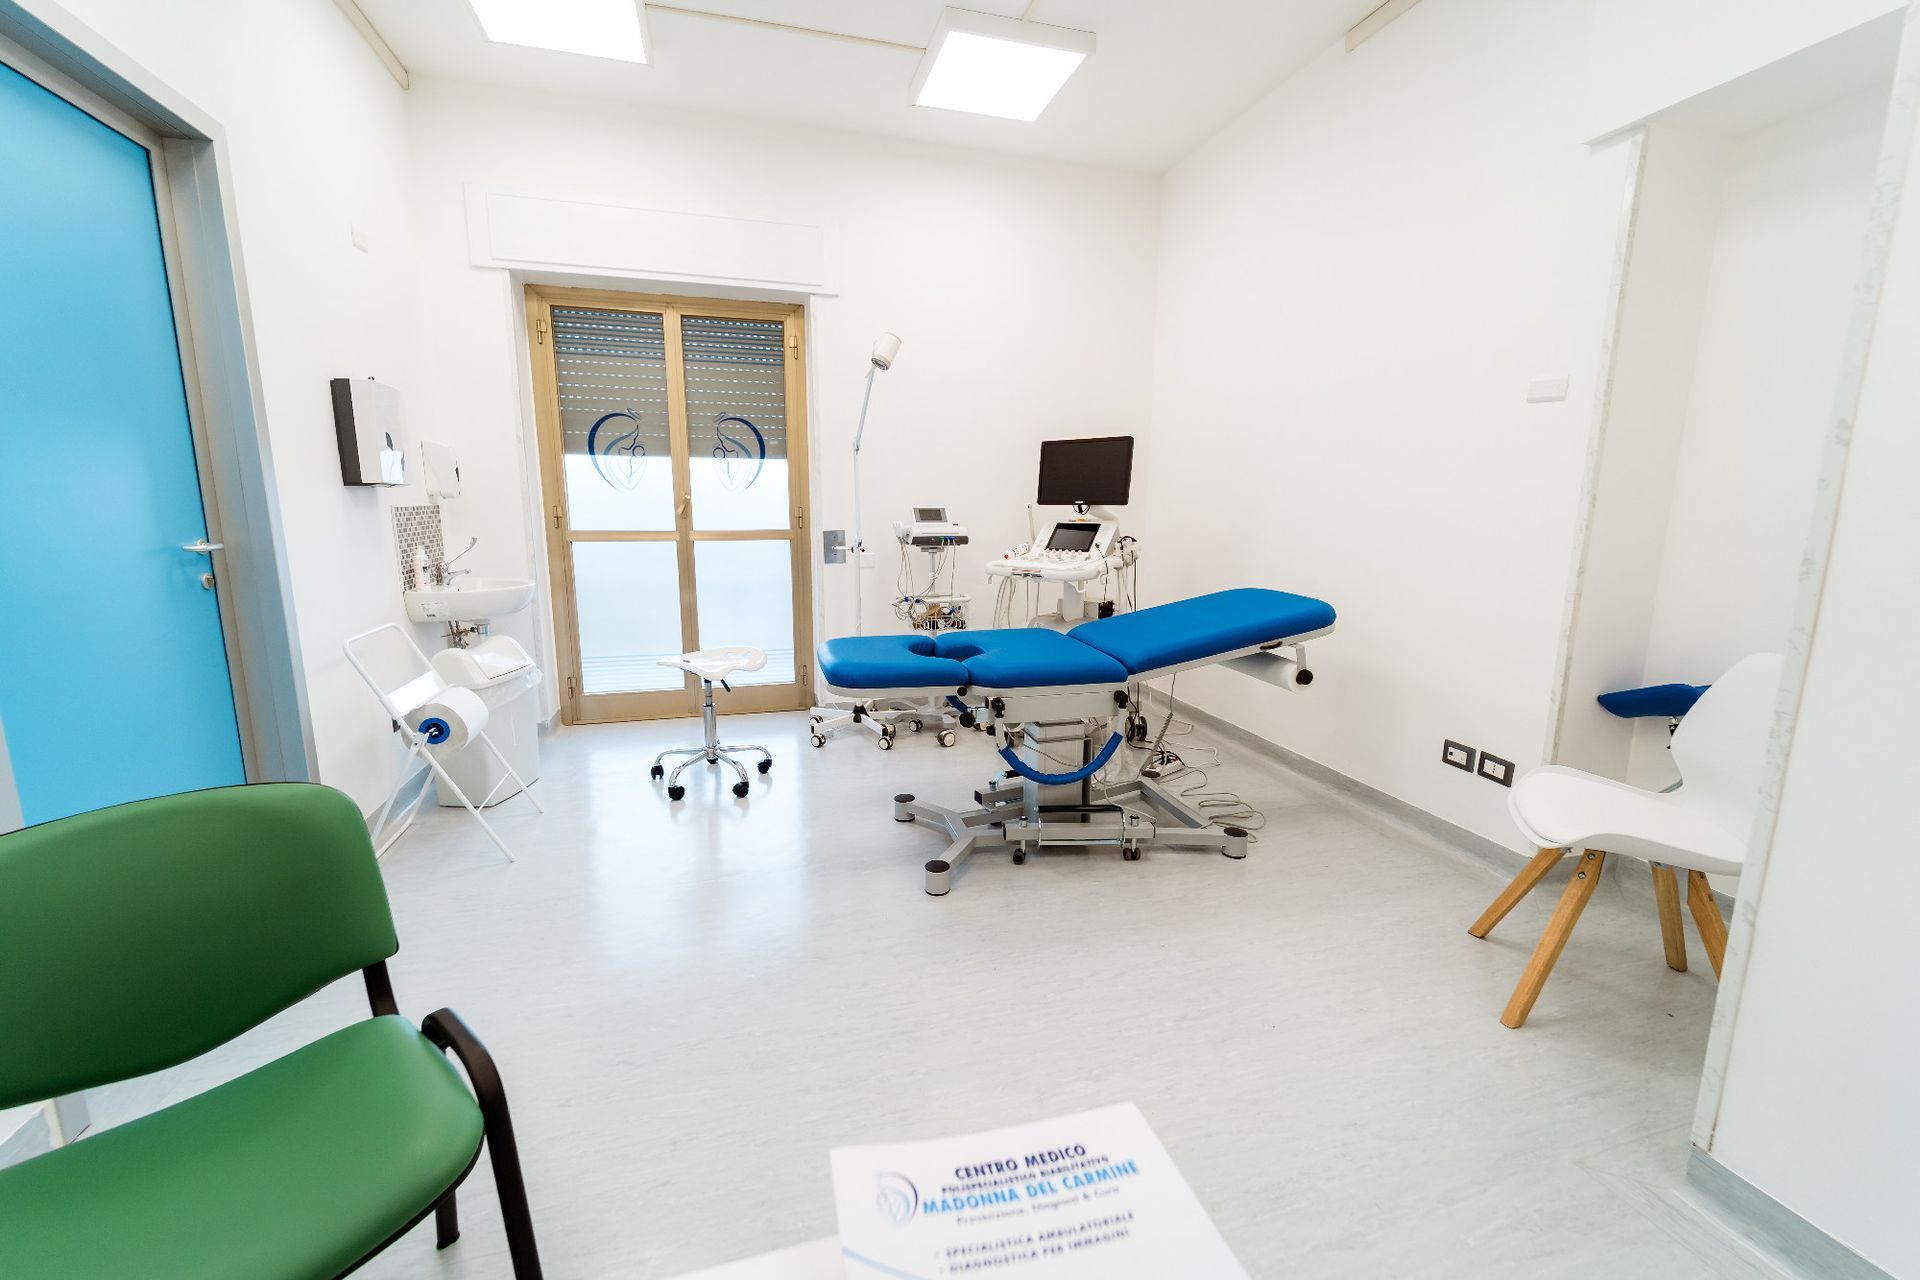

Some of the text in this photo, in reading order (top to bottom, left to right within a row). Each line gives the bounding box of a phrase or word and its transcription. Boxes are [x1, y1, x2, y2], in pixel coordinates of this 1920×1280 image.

[954, 1144, 1086, 1180] CENTRO MEDICO
[922, 1160, 1140, 1215] MADONNA DEL CARMINE
